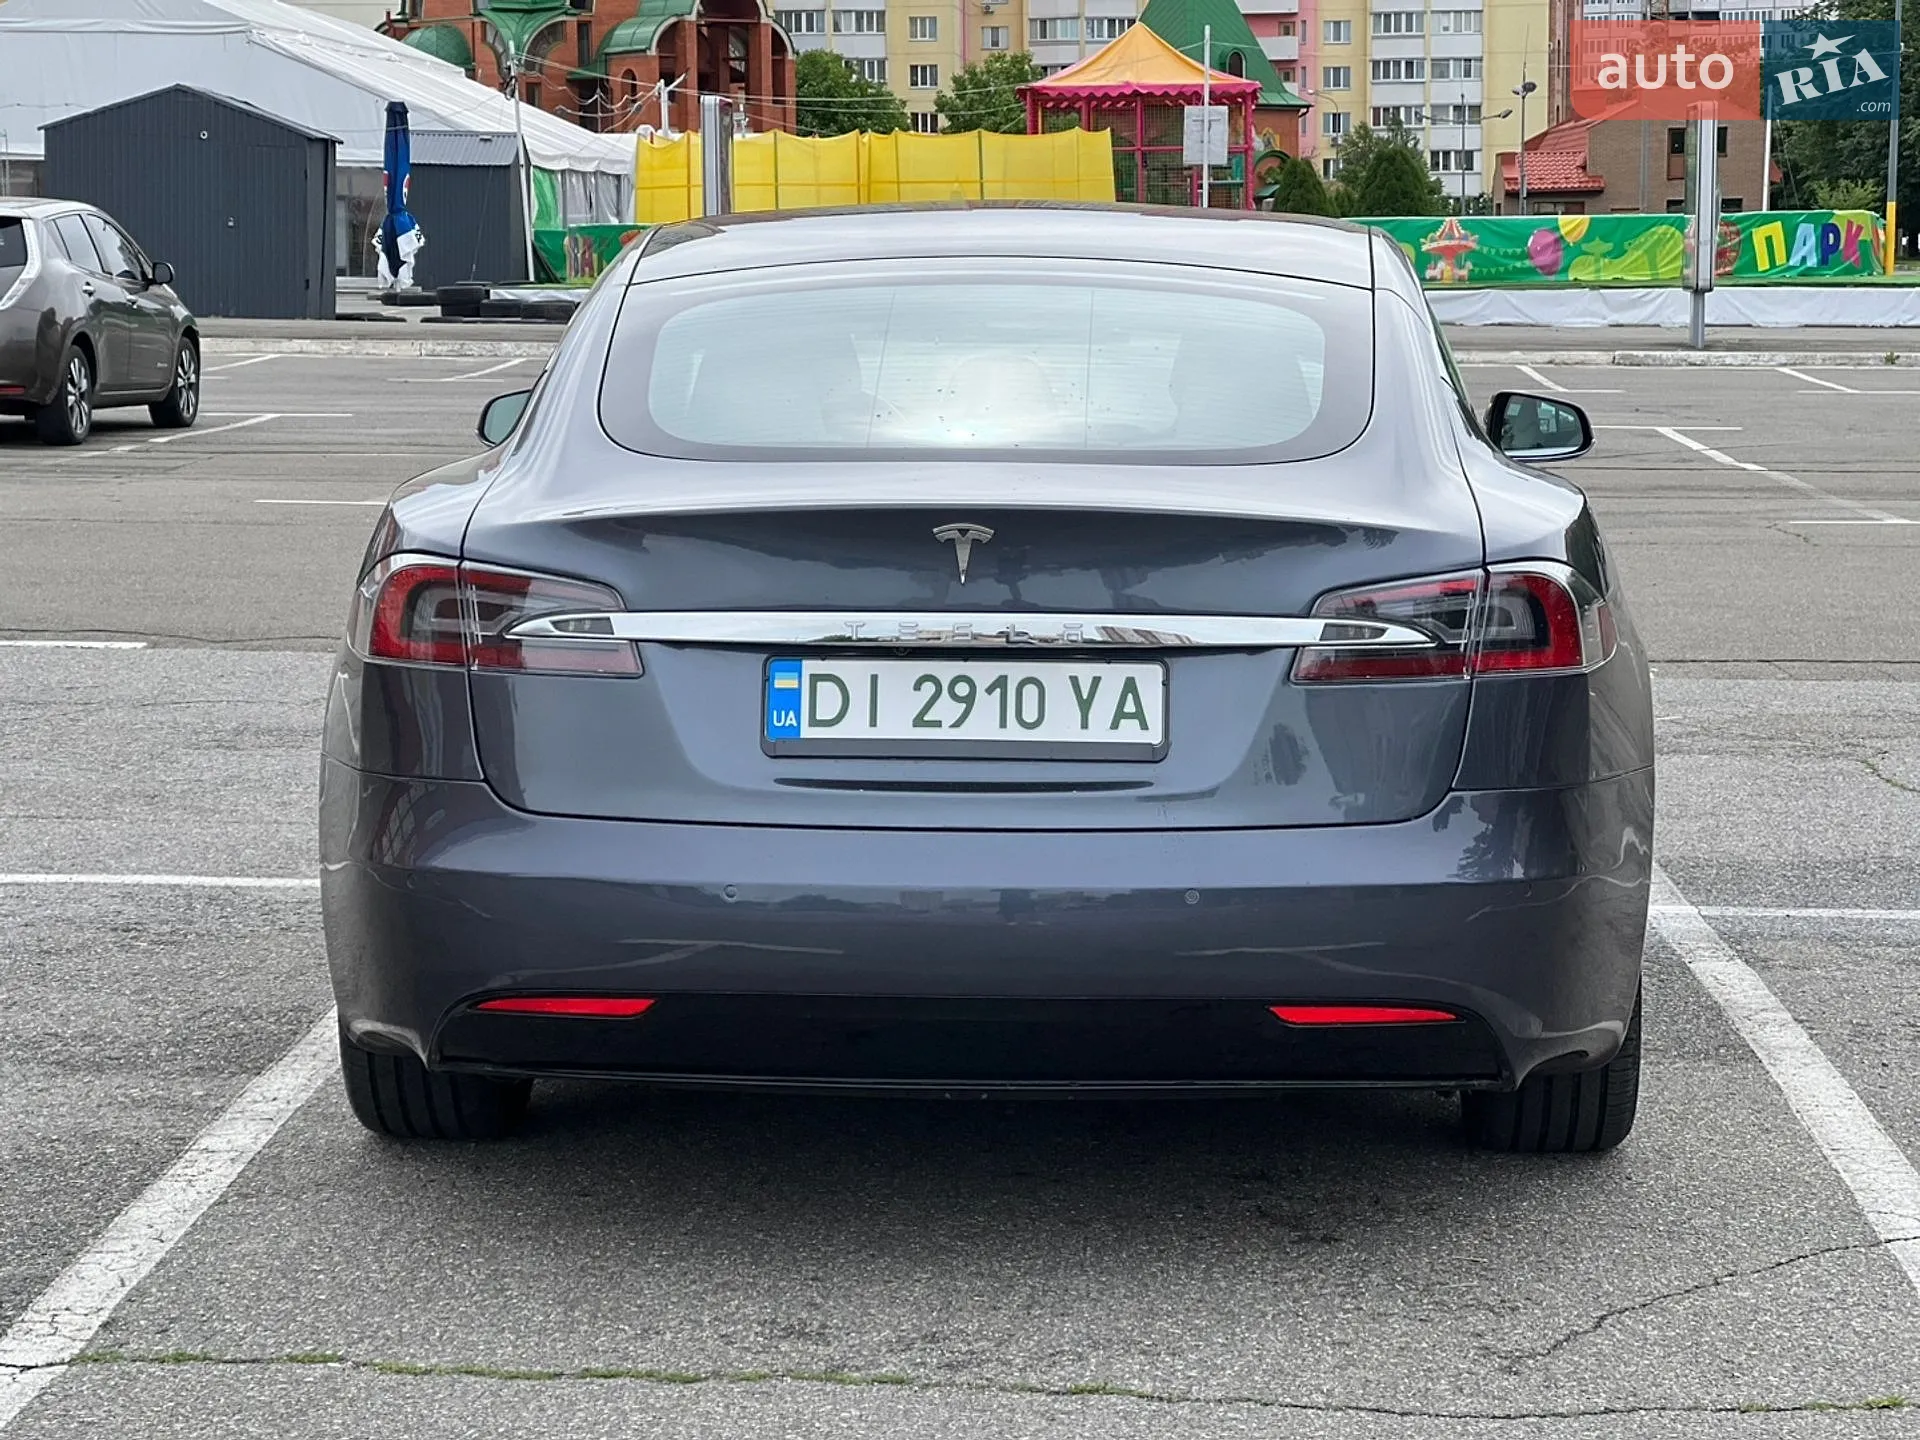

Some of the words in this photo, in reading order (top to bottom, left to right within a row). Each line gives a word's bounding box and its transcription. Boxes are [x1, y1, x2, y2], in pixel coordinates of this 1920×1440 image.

[1752, 219, 1864, 272] ПАРК
[844, 621, 1084, 643] TESLA
[773, 710, 797, 727] UA
[808, 673, 878, 728] DI
[912, 673, 1046, 730] 2910
[1069, 675, 1149, 731] YA
